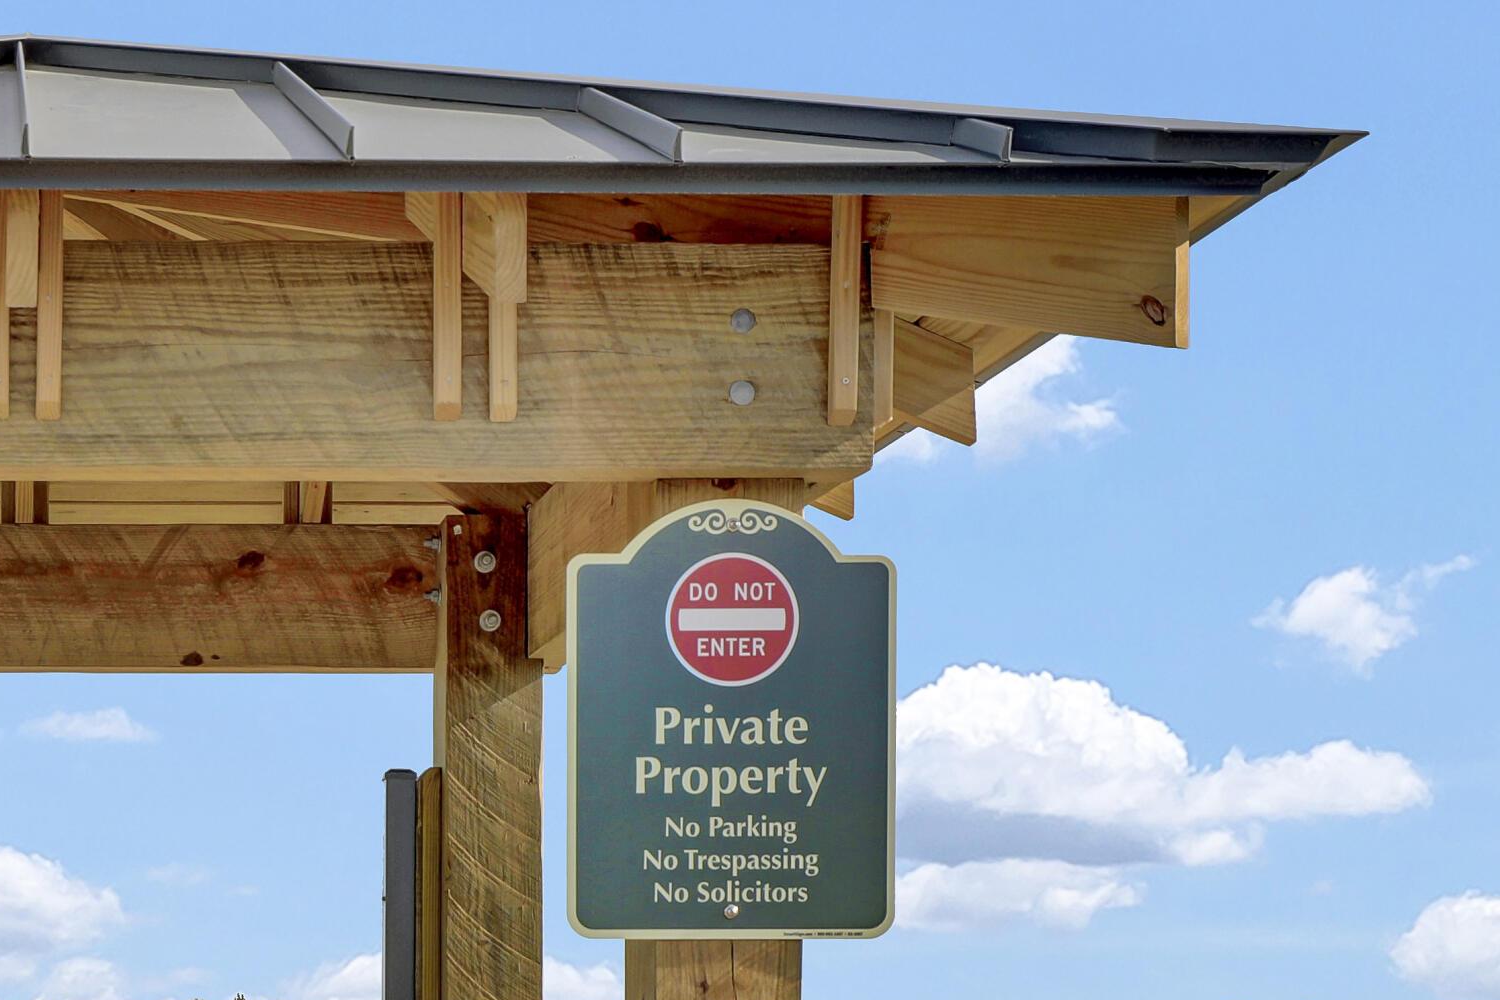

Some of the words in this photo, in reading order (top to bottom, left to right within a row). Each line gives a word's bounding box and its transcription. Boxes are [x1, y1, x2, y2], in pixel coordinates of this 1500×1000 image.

[689, 582, 718, 601] DO
[734, 582, 776, 601] NOT
[697, 637, 766, 657] ENTER
[655, 703, 809, 745] Private
[635, 756, 828, 808] Property
[665, 816, 700, 838] No
[709, 814, 798, 844] Parking
[643, 849, 679, 870] No
[683, 847, 820, 877] Trespassing
[654, 882, 690, 903] No
[697, 880, 809, 903] Solicitors
